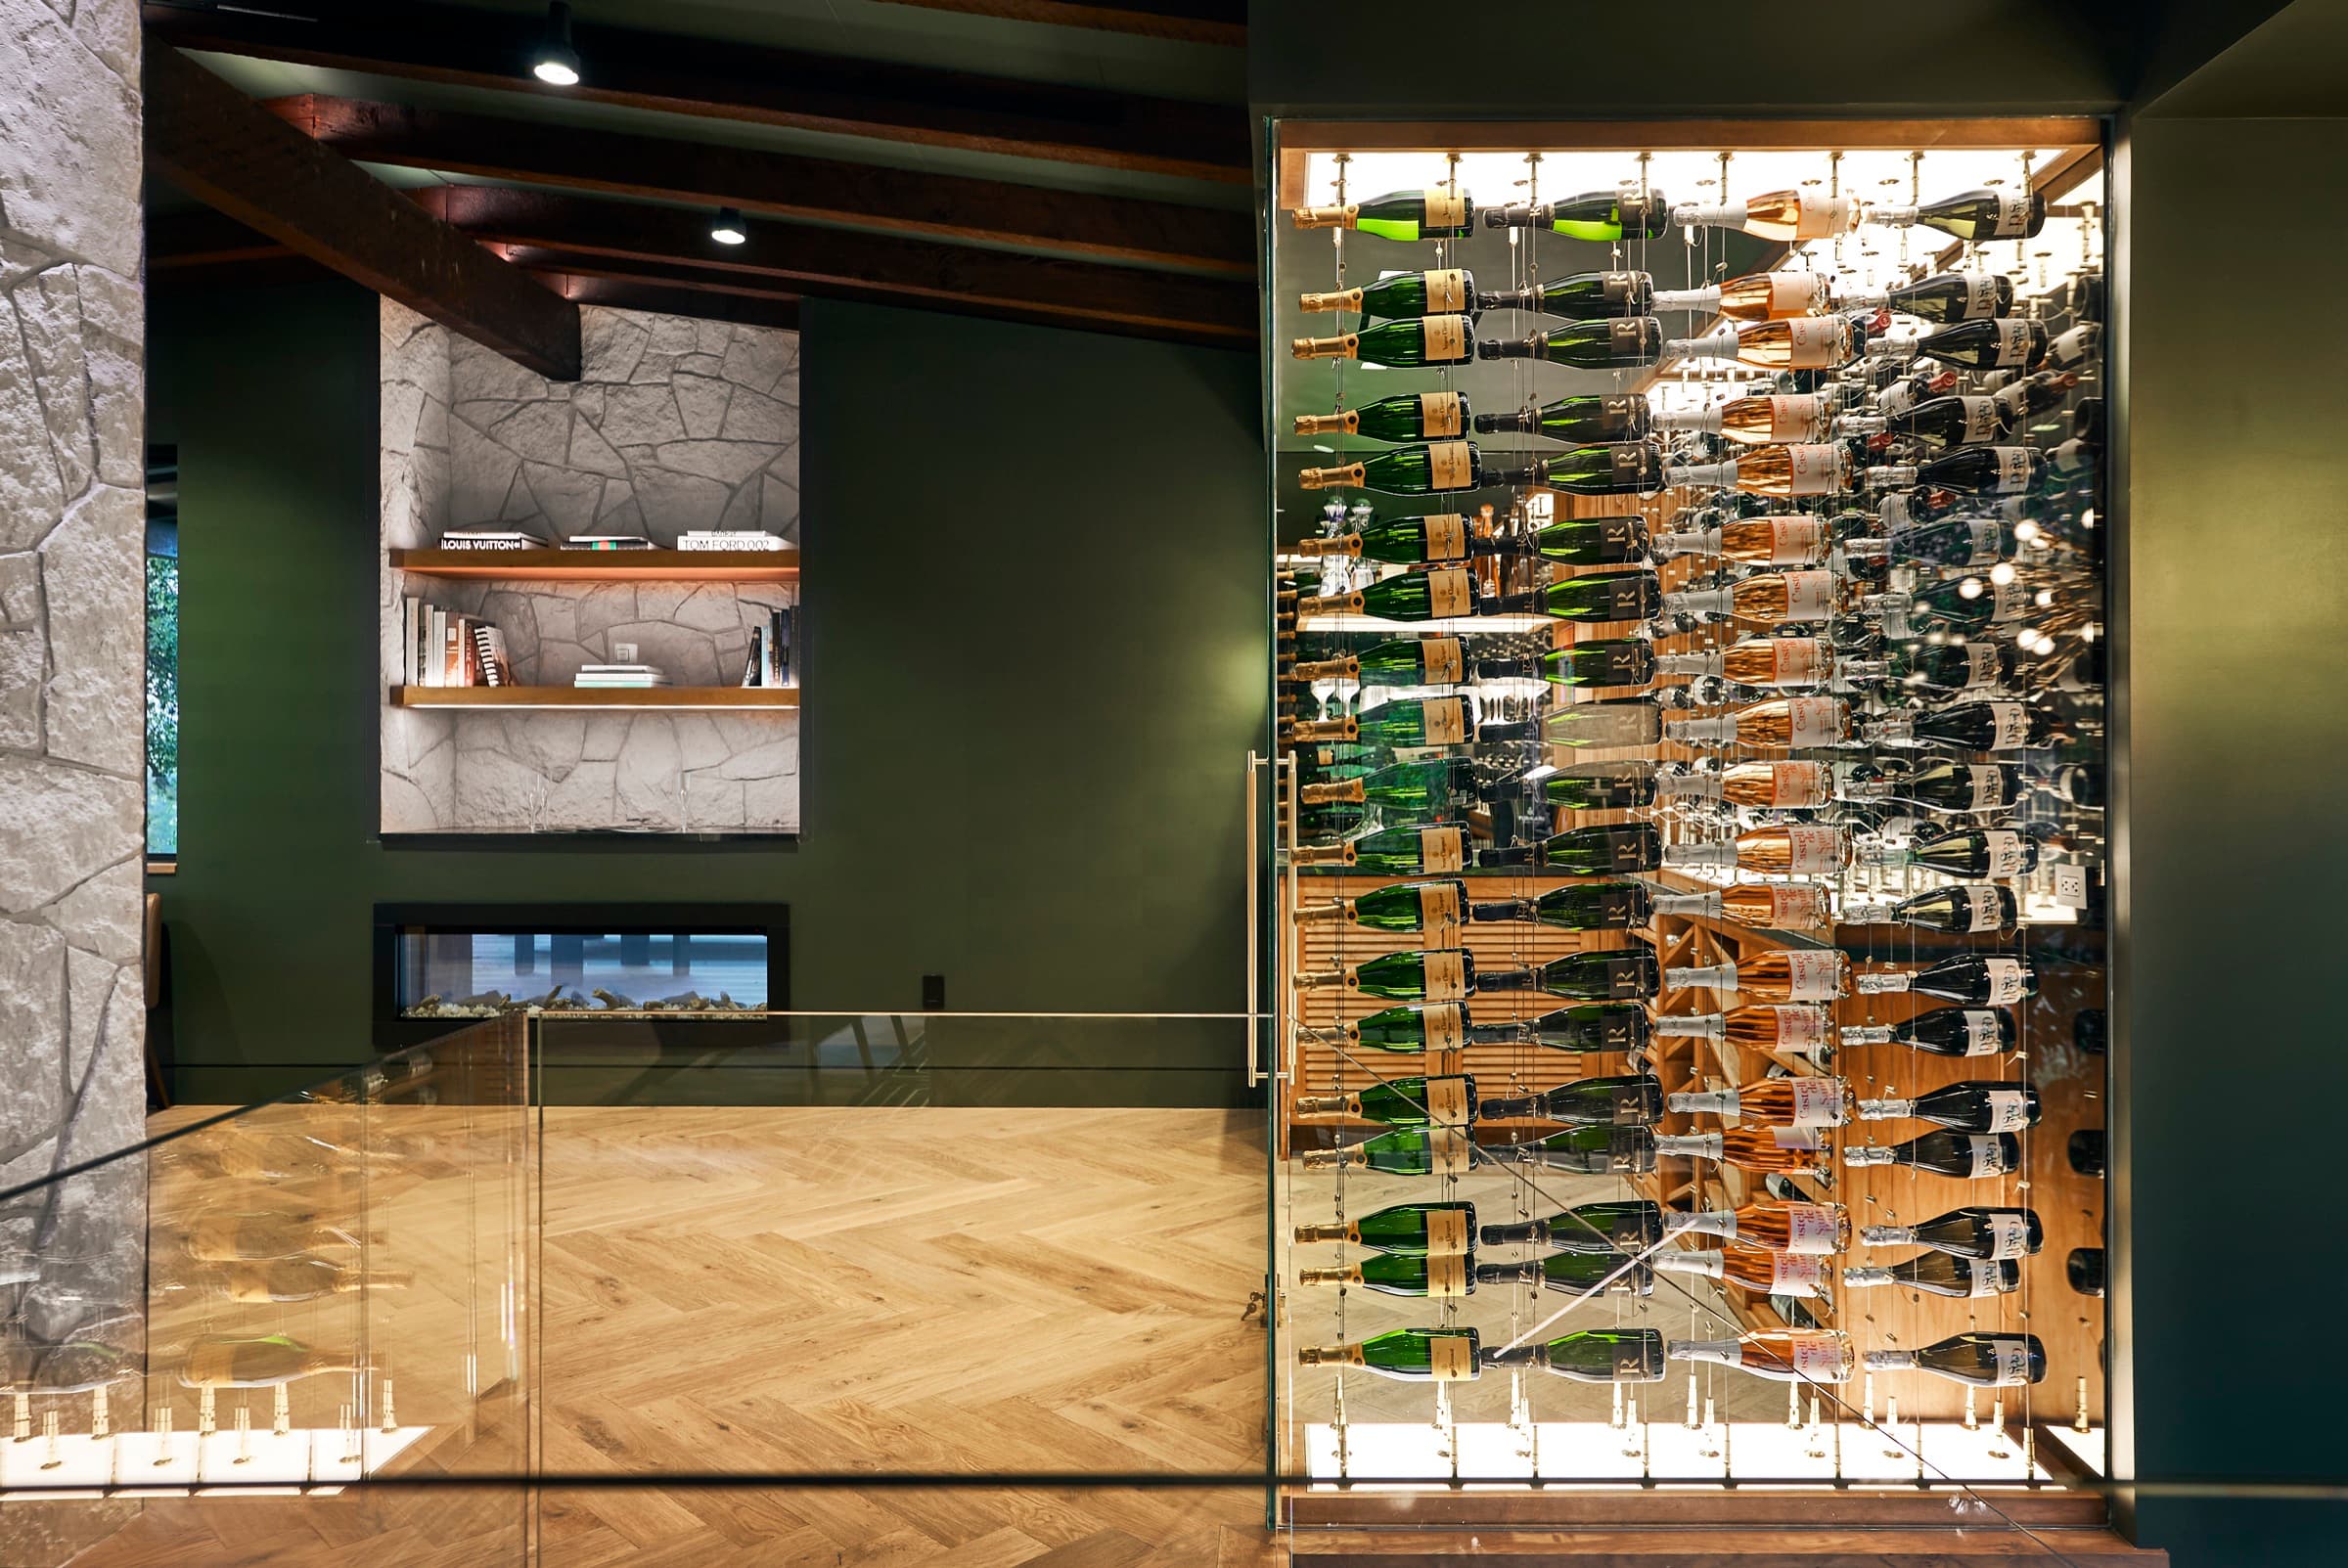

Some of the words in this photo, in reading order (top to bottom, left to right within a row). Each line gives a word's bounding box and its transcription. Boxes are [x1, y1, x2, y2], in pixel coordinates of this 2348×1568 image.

[1623, 193, 1643, 206] R
[1608, 273, 1628, 286] R
[1617, 322, 1636, 336] R
[1608, 399, 1627, 415] R
[1618, 451, 1638, 468] R
[1607, 526, 1626, 542] R
[444, 540, 471, 550] LOUIS
[473, 540, 514, 550] VUITTON
[684, 540, 709, 550] TOM
[712, 540, 745, 550] FORD
[747, 540, 769, 550] 002
[1617, 591, 1636, 607] R
[1612, 653, 1631, 669] R
[1618, 713, 1638, 731] R
[1613, 773, 1632, 788] R
[1805, 831, 1815, 843] de
[1618, 843, 1637, 860] R
[1793, 831, 1806, 868] Castell
[1786, 888, 1797, 901] de
[1608, 905, 1626, 920] R
[1776, 888, 1788, 924] Castell
[1804, 954, 1814, 963] de
[1815, 954, 1825, 975] Sant
[1616, 970, 1635, 987] R
[1792, 954, 1806, 990] Castell
[1790, 1009, 1800, 1020] de
[1780, 1008, 1792, 1045] Castell
[1607, 1027, 1626, 1043] R
[1807, 1082, 1818, 1094] de
[1818, 1082, 1829, 1104] Sant
[1620, 1097, 1639, 1114] R
[1796, 1082, 1809, 1119] Castell
[1613, 1153, 1631, 1168] R
[1804, 1210, 1815, 1223] de
[1815, 1211, 1826, 1235] Sant
[1792, 1210, 1805, 1247] Castell
[1619, 1230, 1638, 1245] R
[1786, 1253, 1797, 1267] de
[1797, 1254, 1807, 1278] Sant
[1610, 1277, 1631, 1291] R
[1808, 1341, 1818, 1356] de
[1619, 1358, 1640, 1374] R
